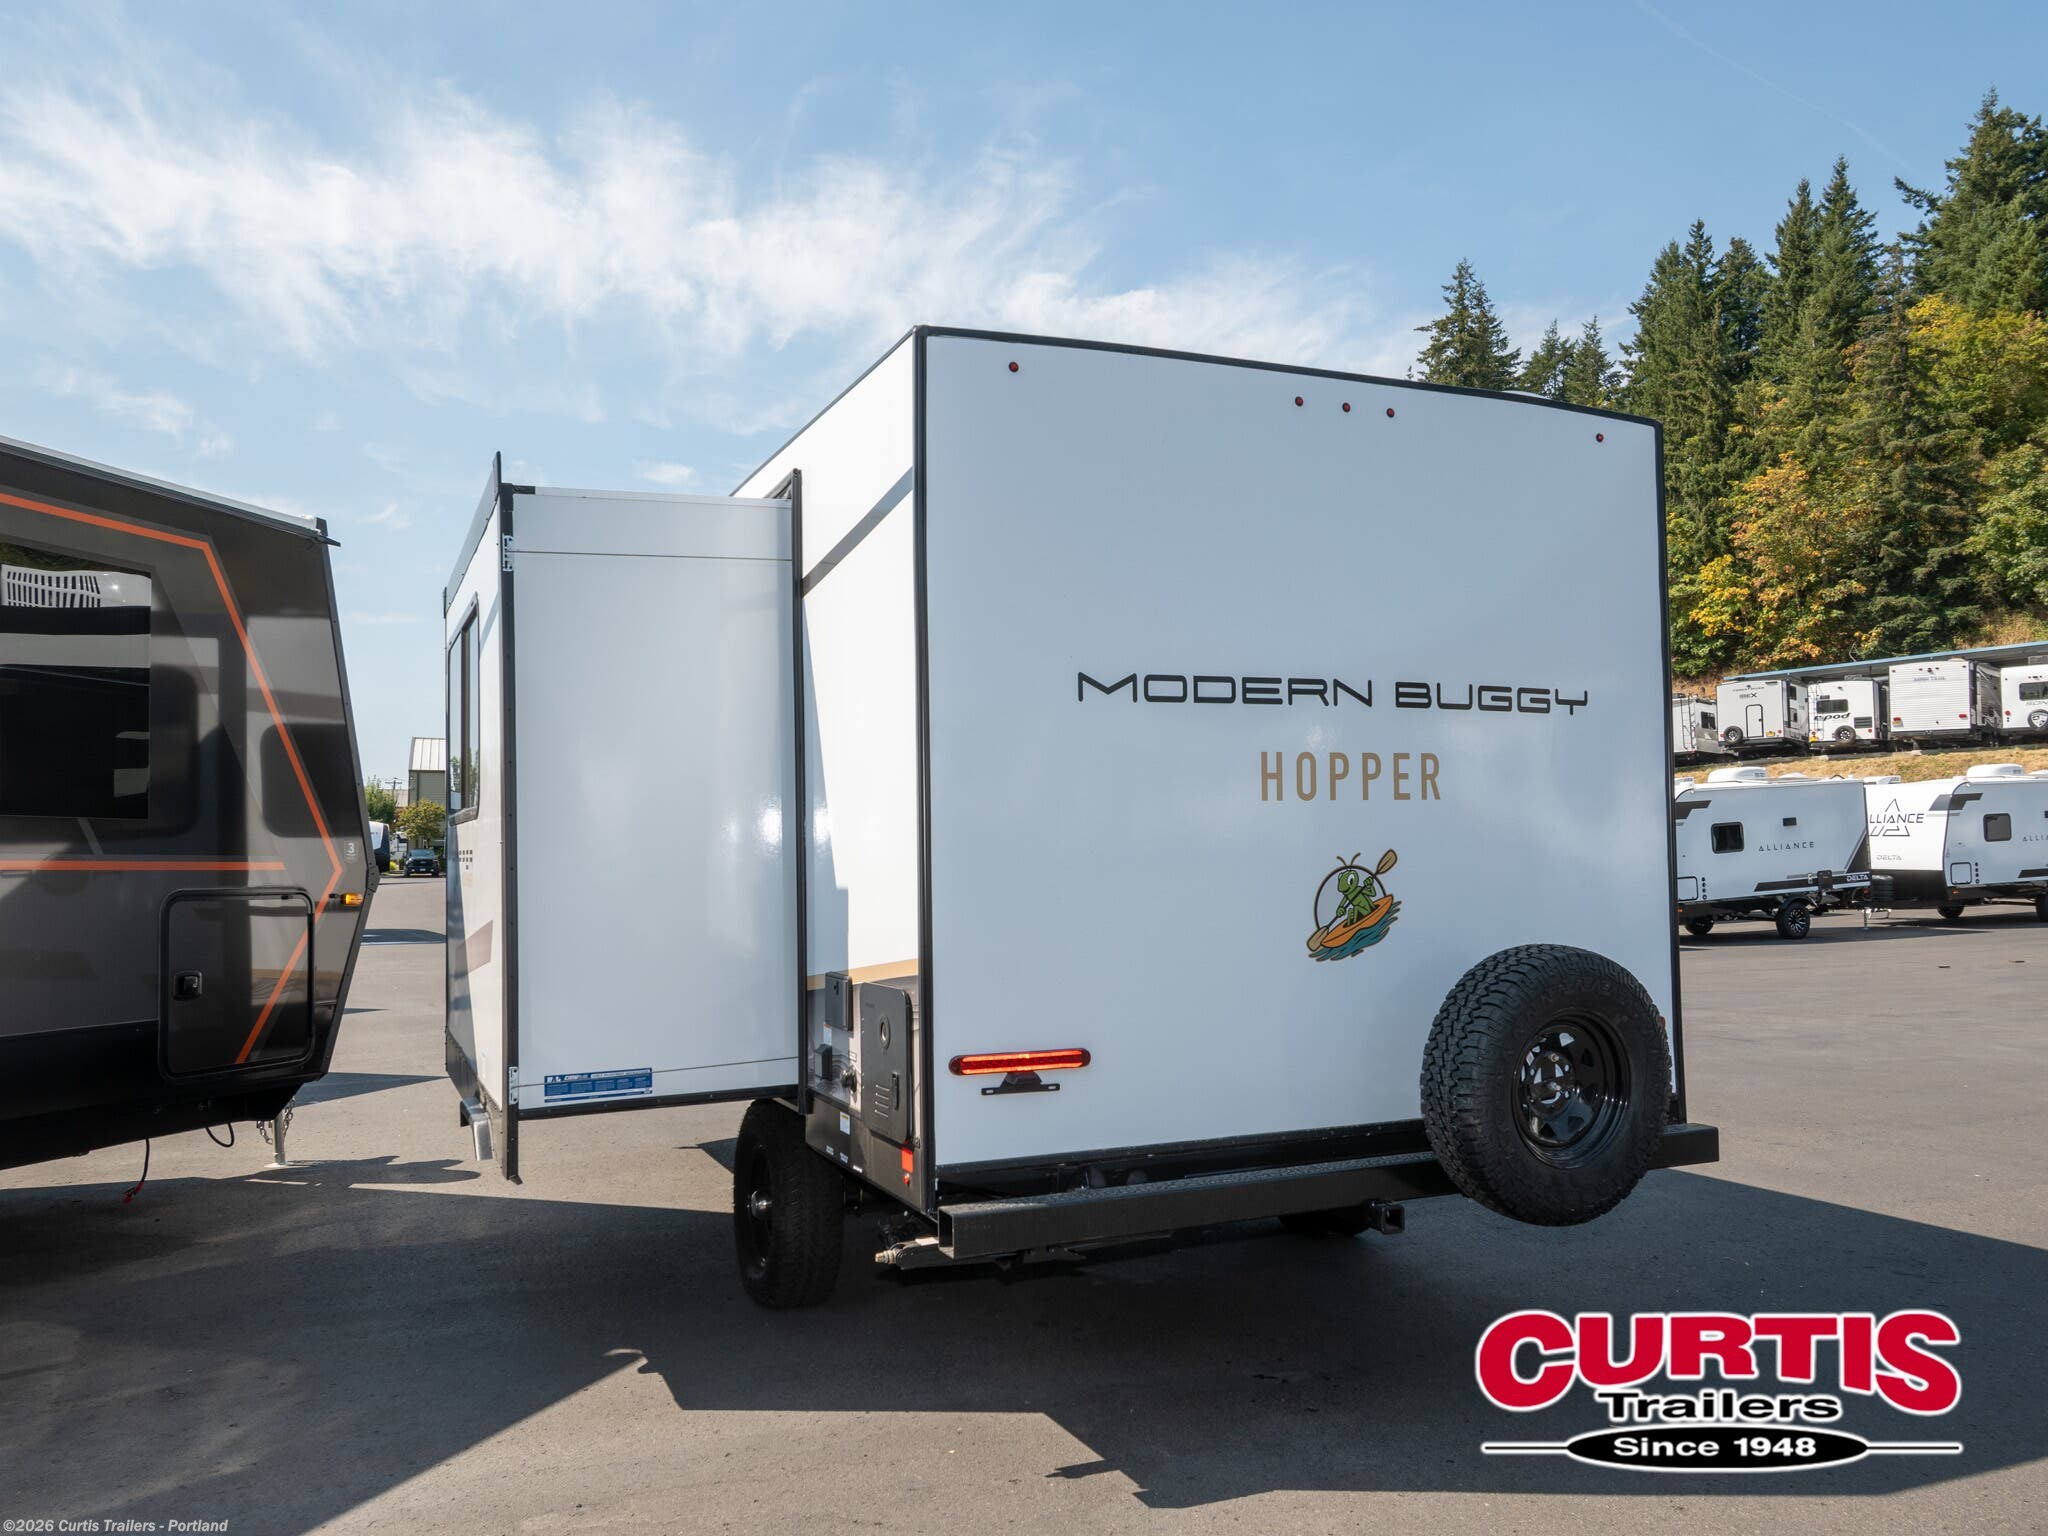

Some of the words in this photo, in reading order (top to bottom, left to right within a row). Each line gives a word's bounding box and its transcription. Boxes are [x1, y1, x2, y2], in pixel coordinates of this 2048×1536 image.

[1077, 671, 1373, 707] MODERN
[1394, 681, 1588, 715] BUGGY
[1260, 751, 1441, 801] HOPPER
[1869, 813, 1925, 823] LLIANCE
[1758, 841, 1815, 852] ALLIANCE
[1846, 874, 1869, 882] DELTA
